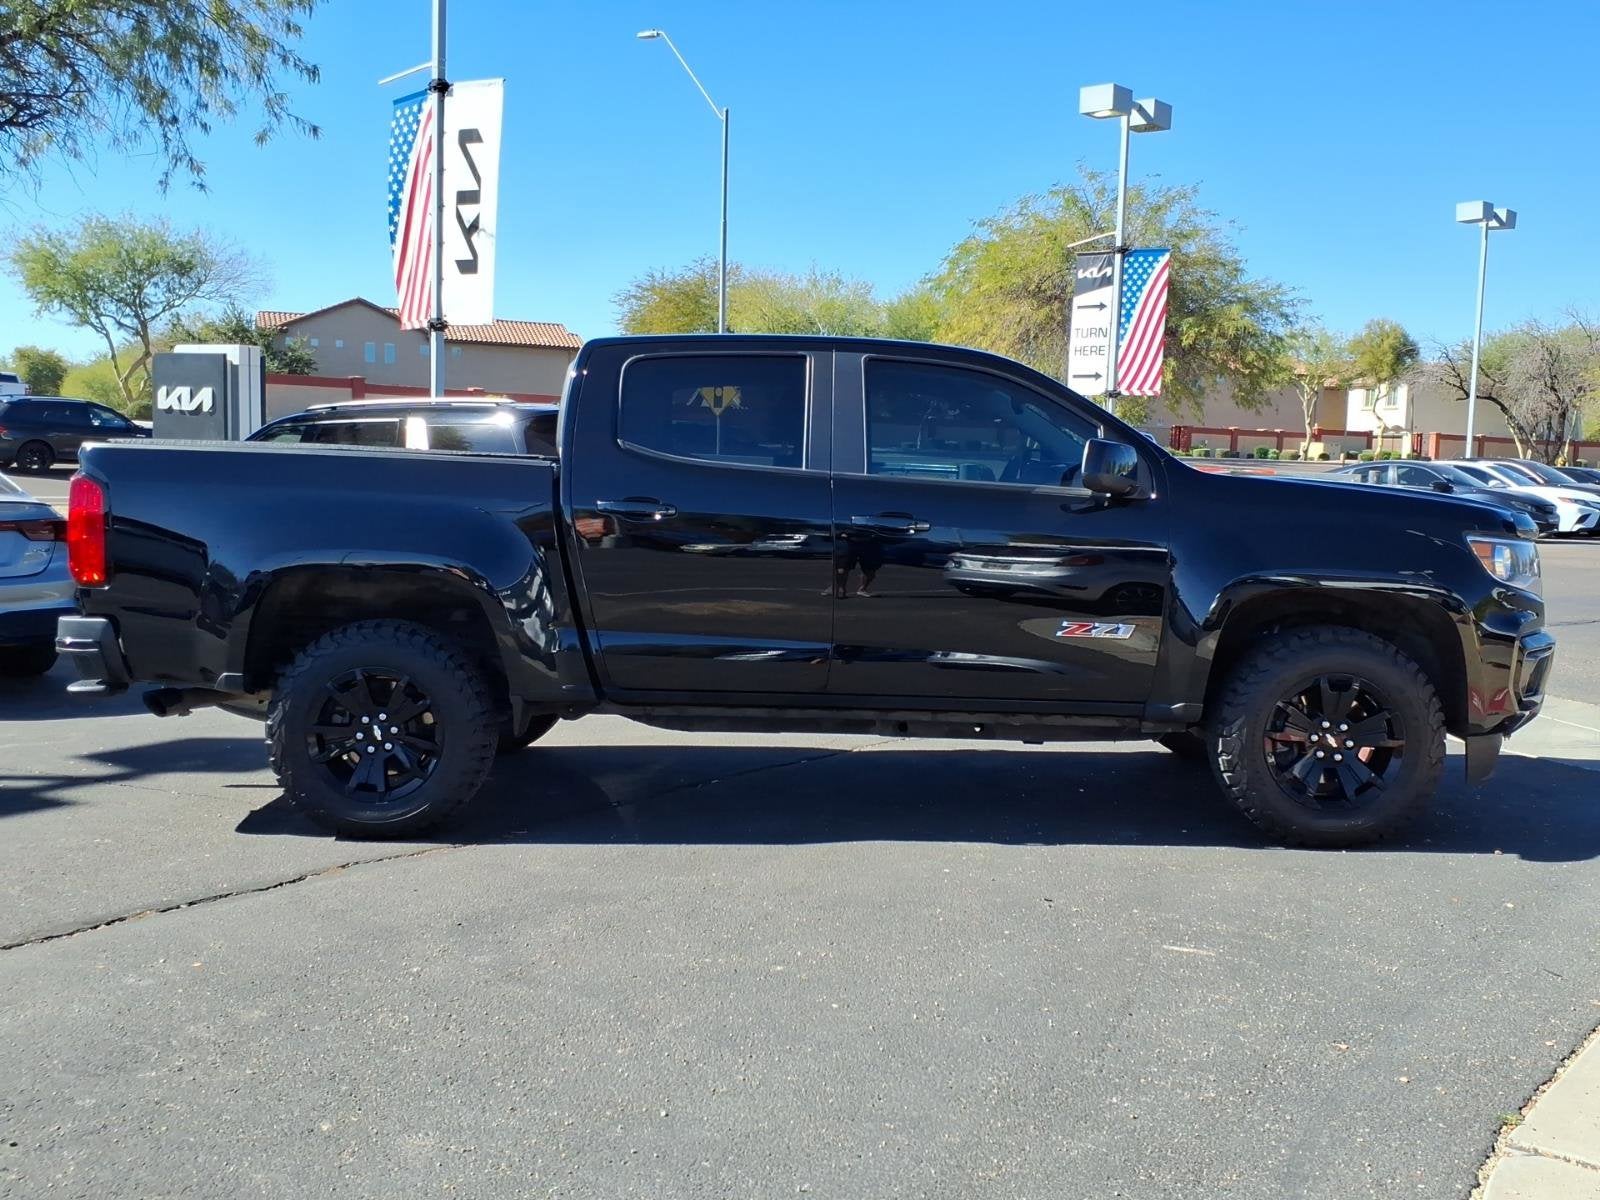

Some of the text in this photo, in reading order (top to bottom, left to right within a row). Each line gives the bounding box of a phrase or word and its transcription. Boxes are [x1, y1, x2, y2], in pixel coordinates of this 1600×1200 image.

[455, 128, 484, 274] KIA
[1078, 266, 1112, 279] KIA
[1074, 327, 1107, 339] TURN
[1074, 345, 1105, 356] HERE
[157, 385, 213, 412] KIA
[1056, 620, 1136, 639] Z71
